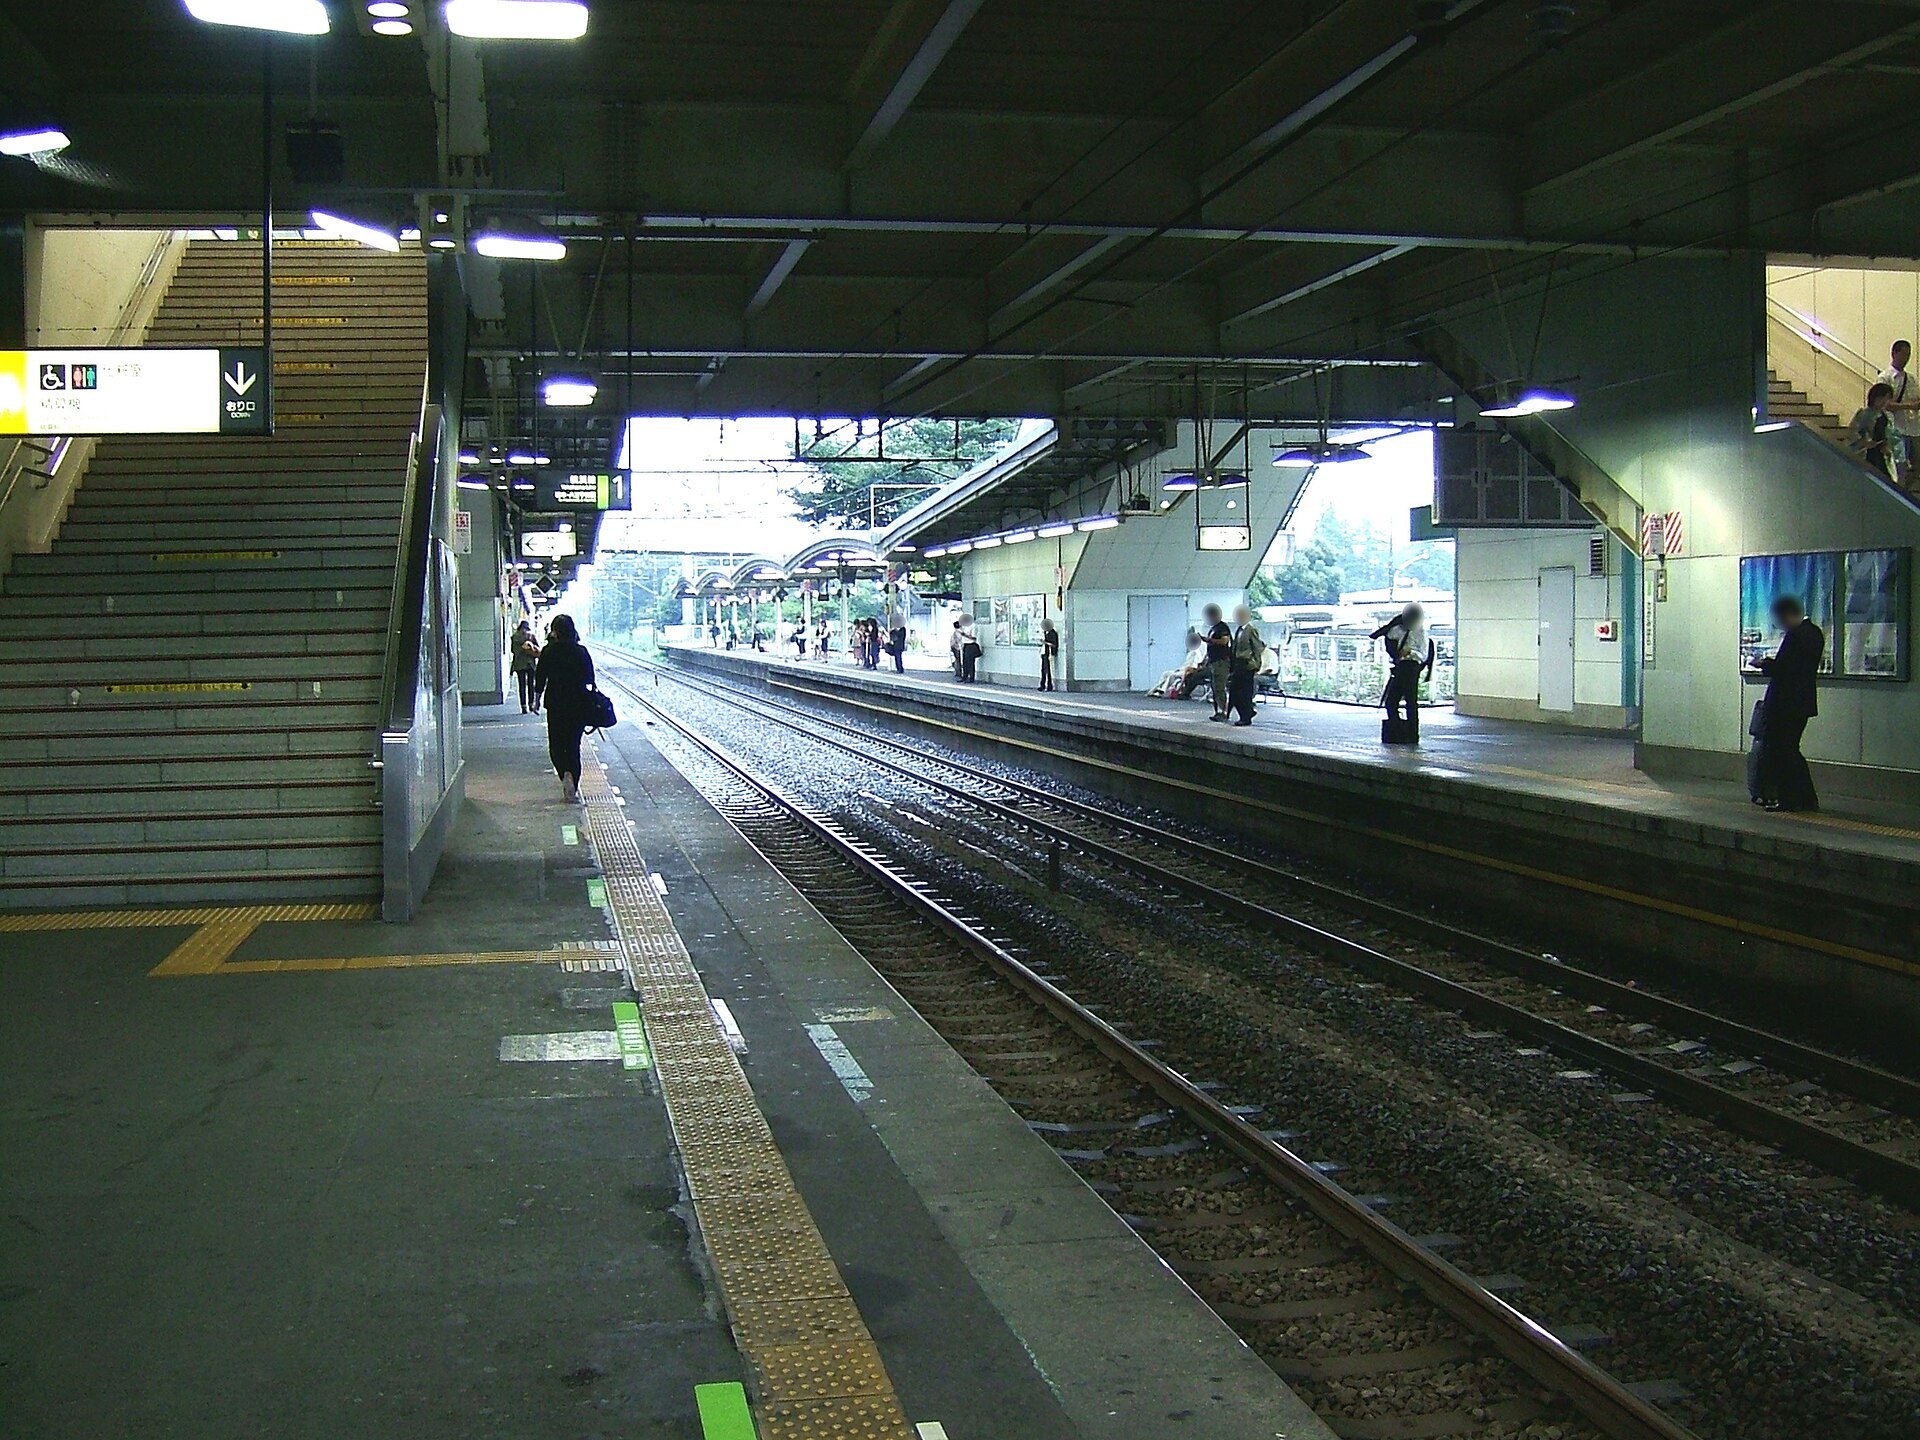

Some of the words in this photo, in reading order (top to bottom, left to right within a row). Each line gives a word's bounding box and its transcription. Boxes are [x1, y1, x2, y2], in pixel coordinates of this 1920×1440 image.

[226, 401, 256, 412] おり口
[612, 475, 623, 500] 1
